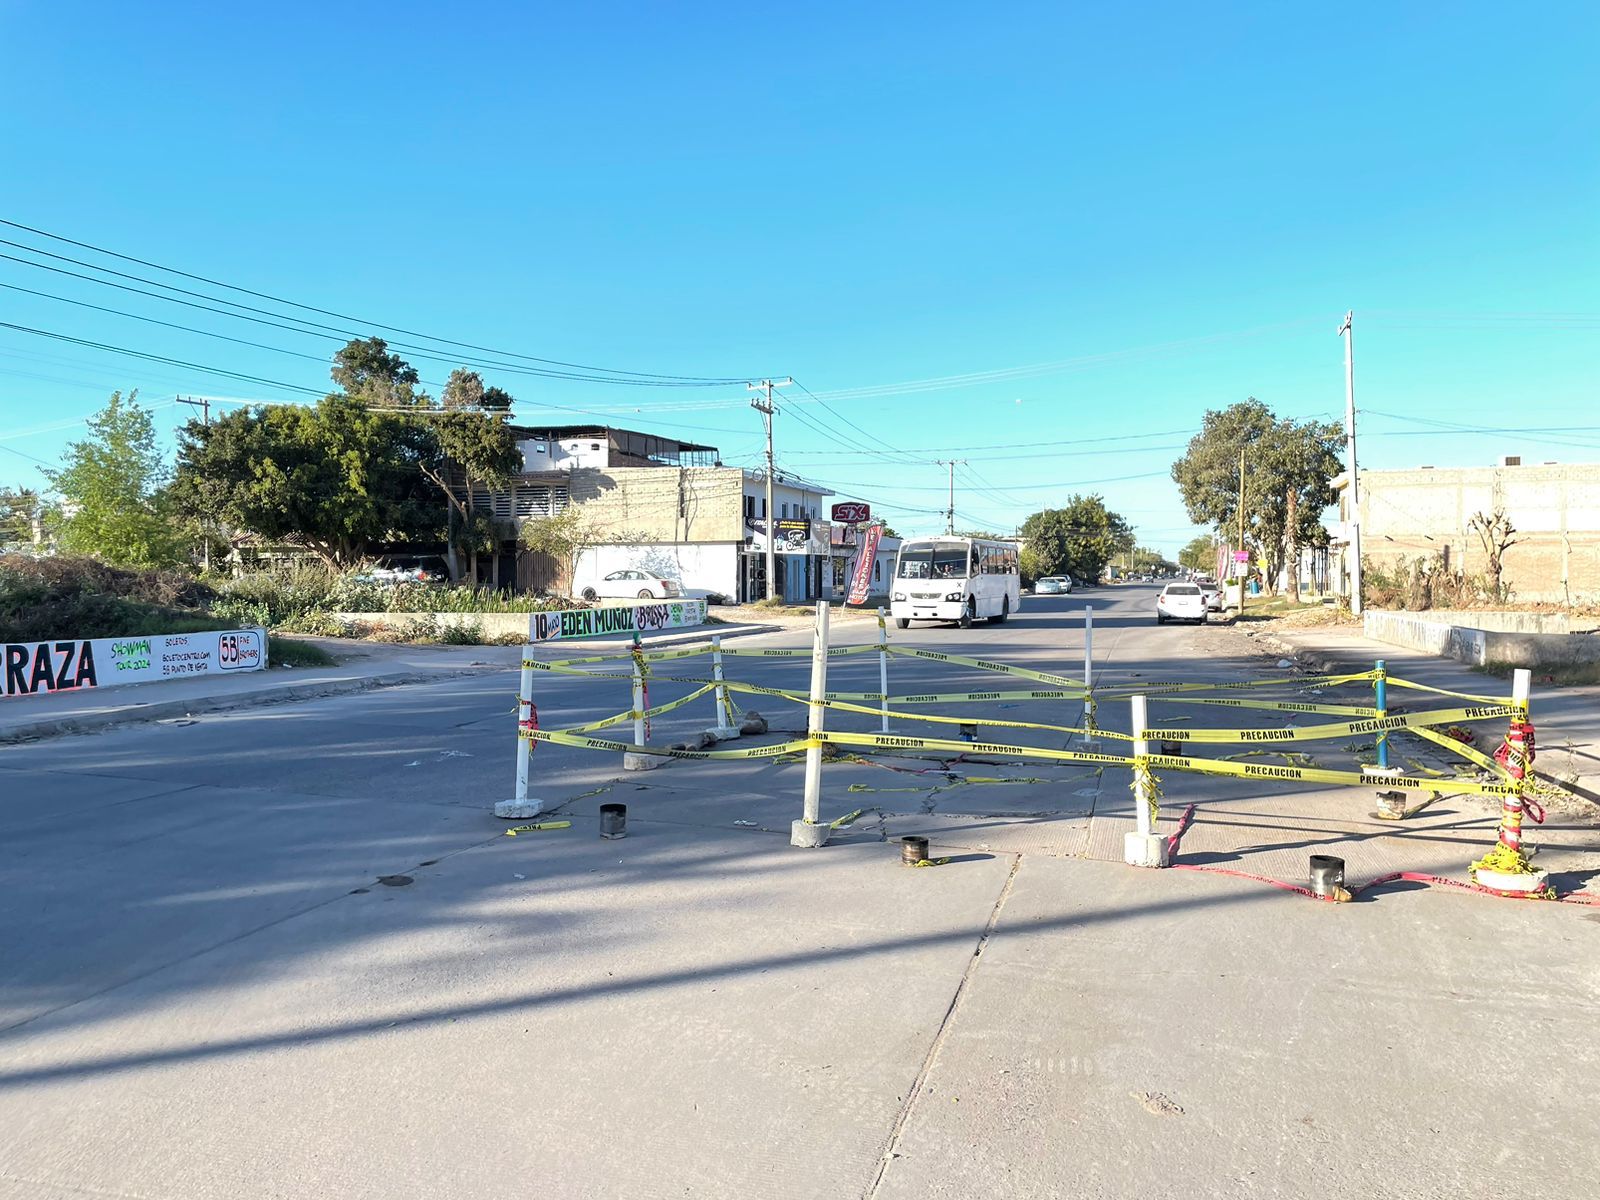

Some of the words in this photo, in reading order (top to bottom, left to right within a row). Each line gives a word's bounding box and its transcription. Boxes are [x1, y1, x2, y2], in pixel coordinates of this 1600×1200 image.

[535, 614, 548, 639] 10
[561, 611, 592, 636] EDEN
[594, 607, 634, 634] MUÑOZ
[111, 639, 152, 659] SHOWMAN
[222, 636, 238, 662] 5B
[0, 641, 98, 694] RAZA
[116, 661, 132, 671] TOUR
[187, 663, 194, 672] DE
[1349, 716, 1408, 733] PRECAUCION
[875, 736, 924, 747] PRECAUCION
[1142, 731, 1190, 740] PRECAUCION
[1240, 730, 1295, 741] PRECAUCION
[586, 739, 628, 751] PRECAUCION
[972, 744, 1023, 754] PRECAUCION
[1137, 755, 1190, 767] PRECAUCION
[1245, 766, 1302, 778] PRECAUCION
[1360, 775, 1420, 787] PRECAUCION
